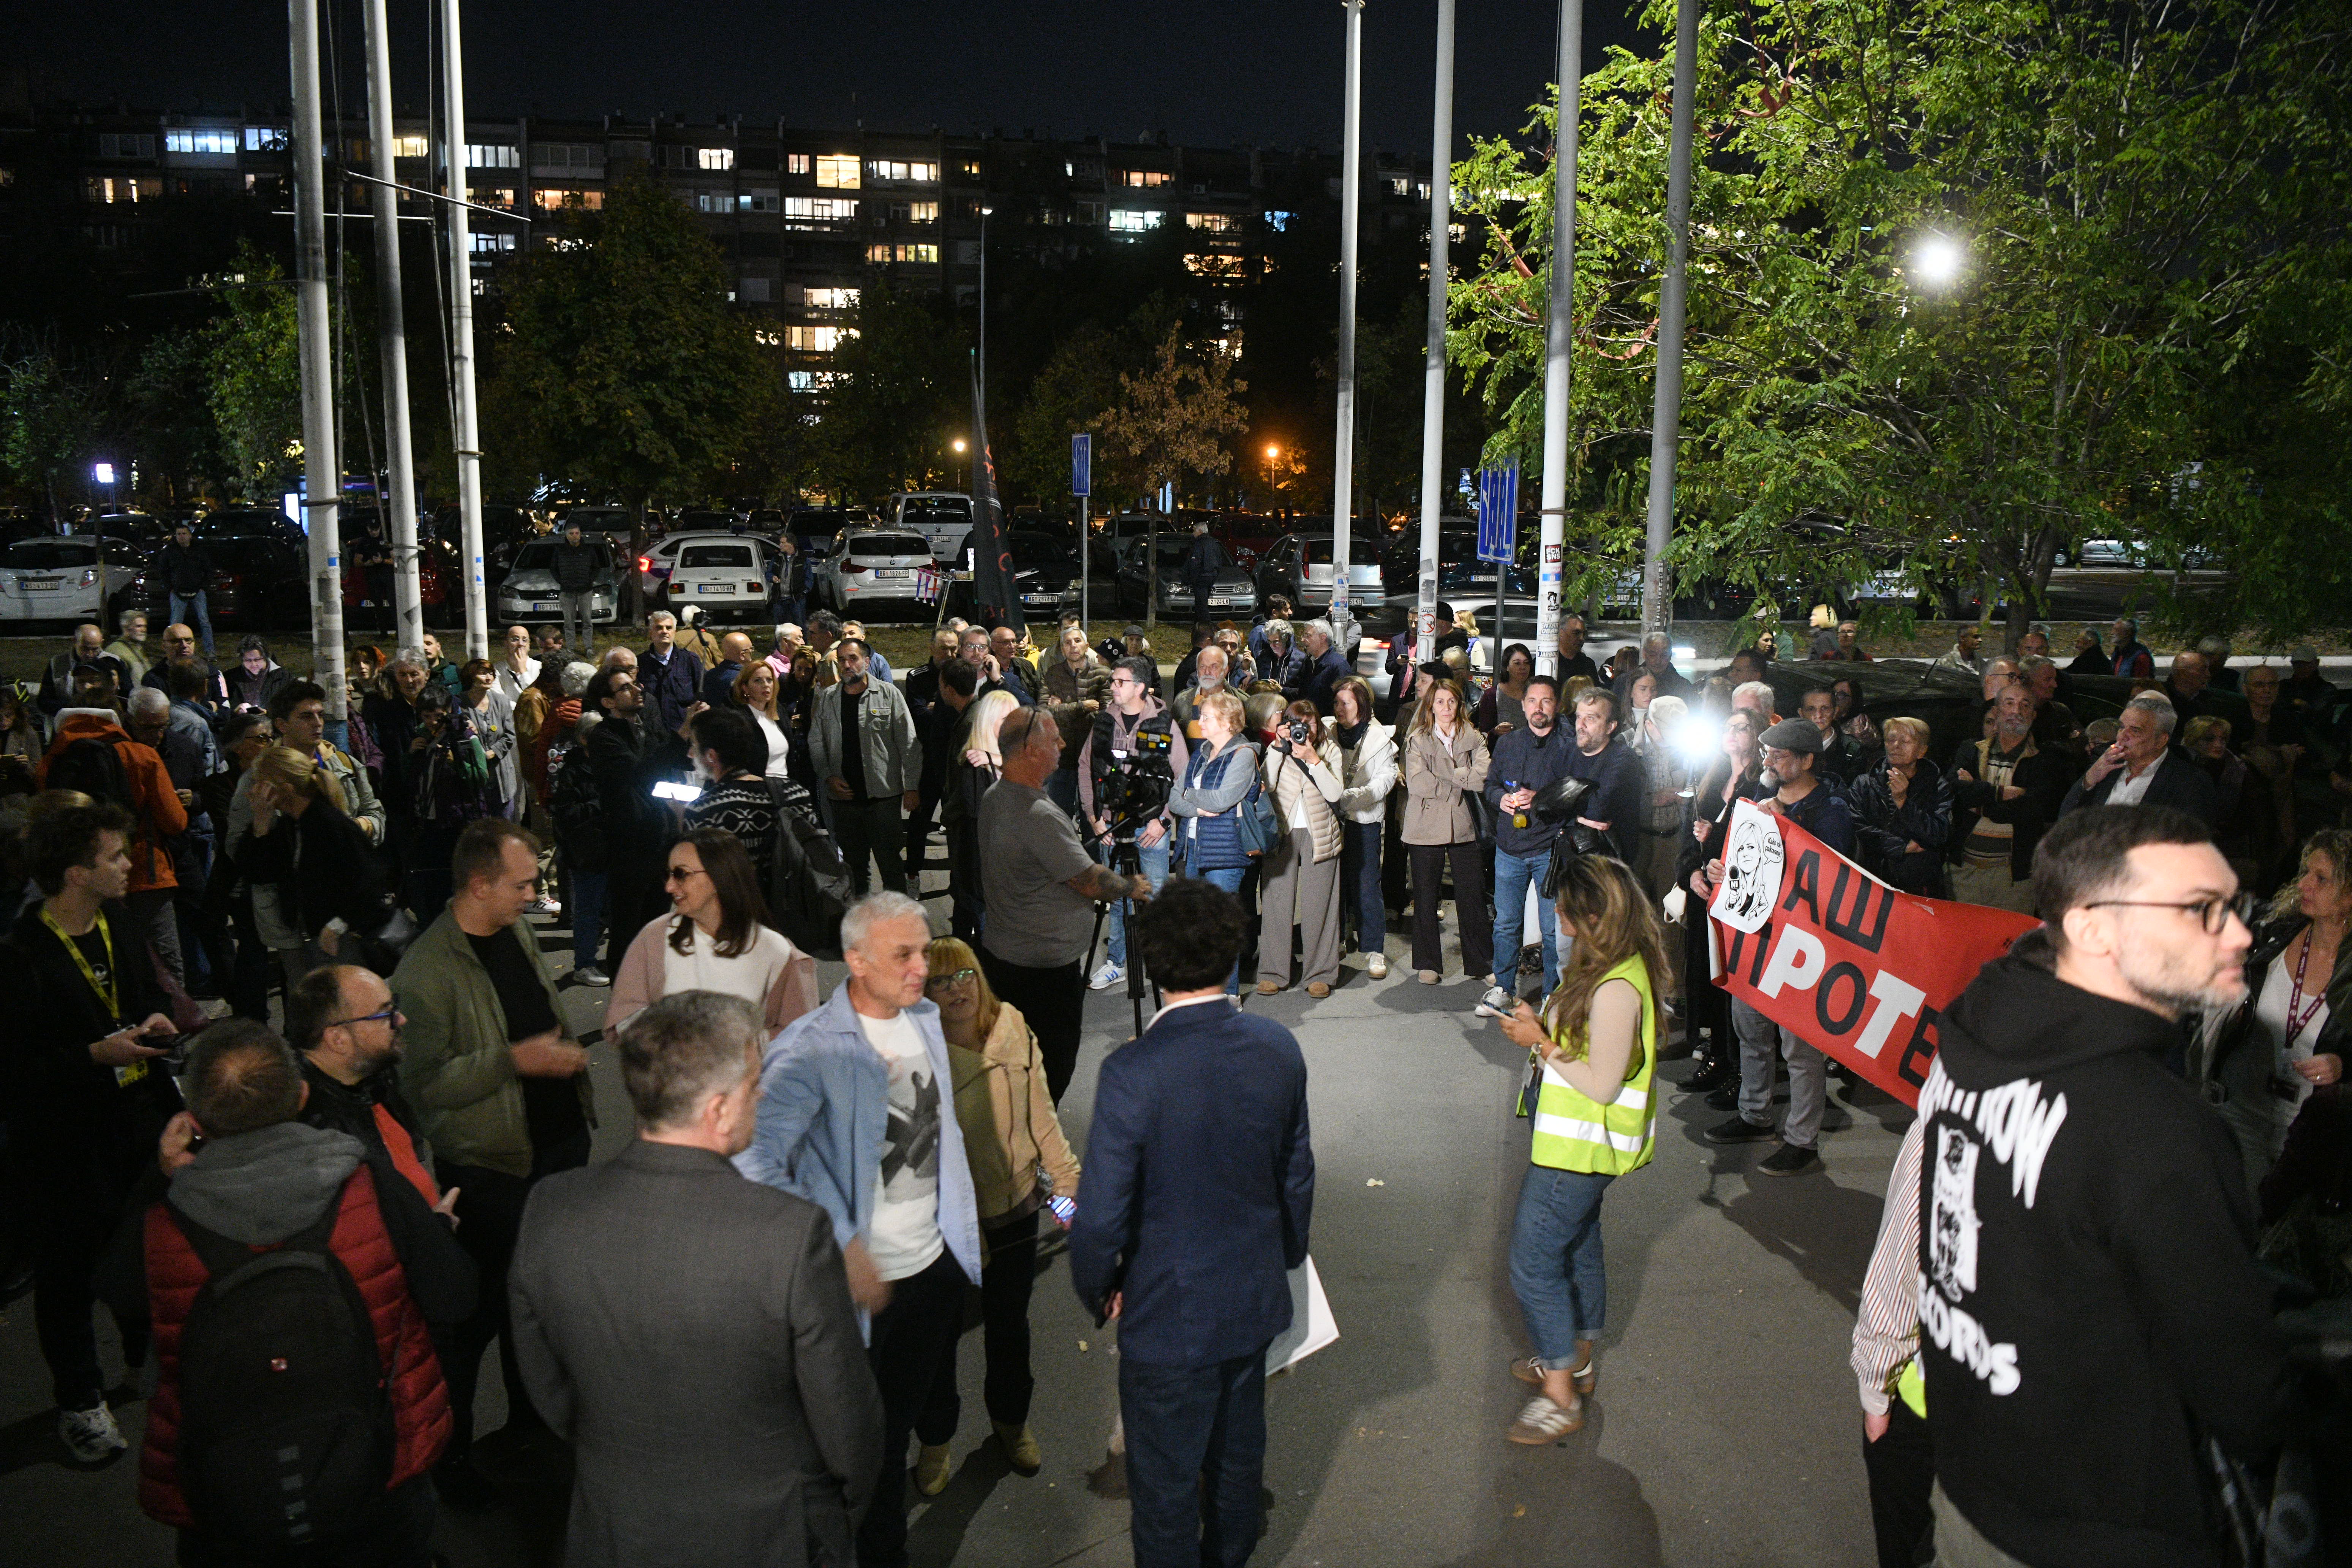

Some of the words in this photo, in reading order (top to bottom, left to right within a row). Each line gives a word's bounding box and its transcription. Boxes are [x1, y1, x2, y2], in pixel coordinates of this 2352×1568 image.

[1765, 846, 1783, 859] pakovanje?
[1767, 836, 1777, 846] Kako
[1781, 849, 1895, 953] АШ
[1728, 921, 1939, 1088] ПРОТЕ
